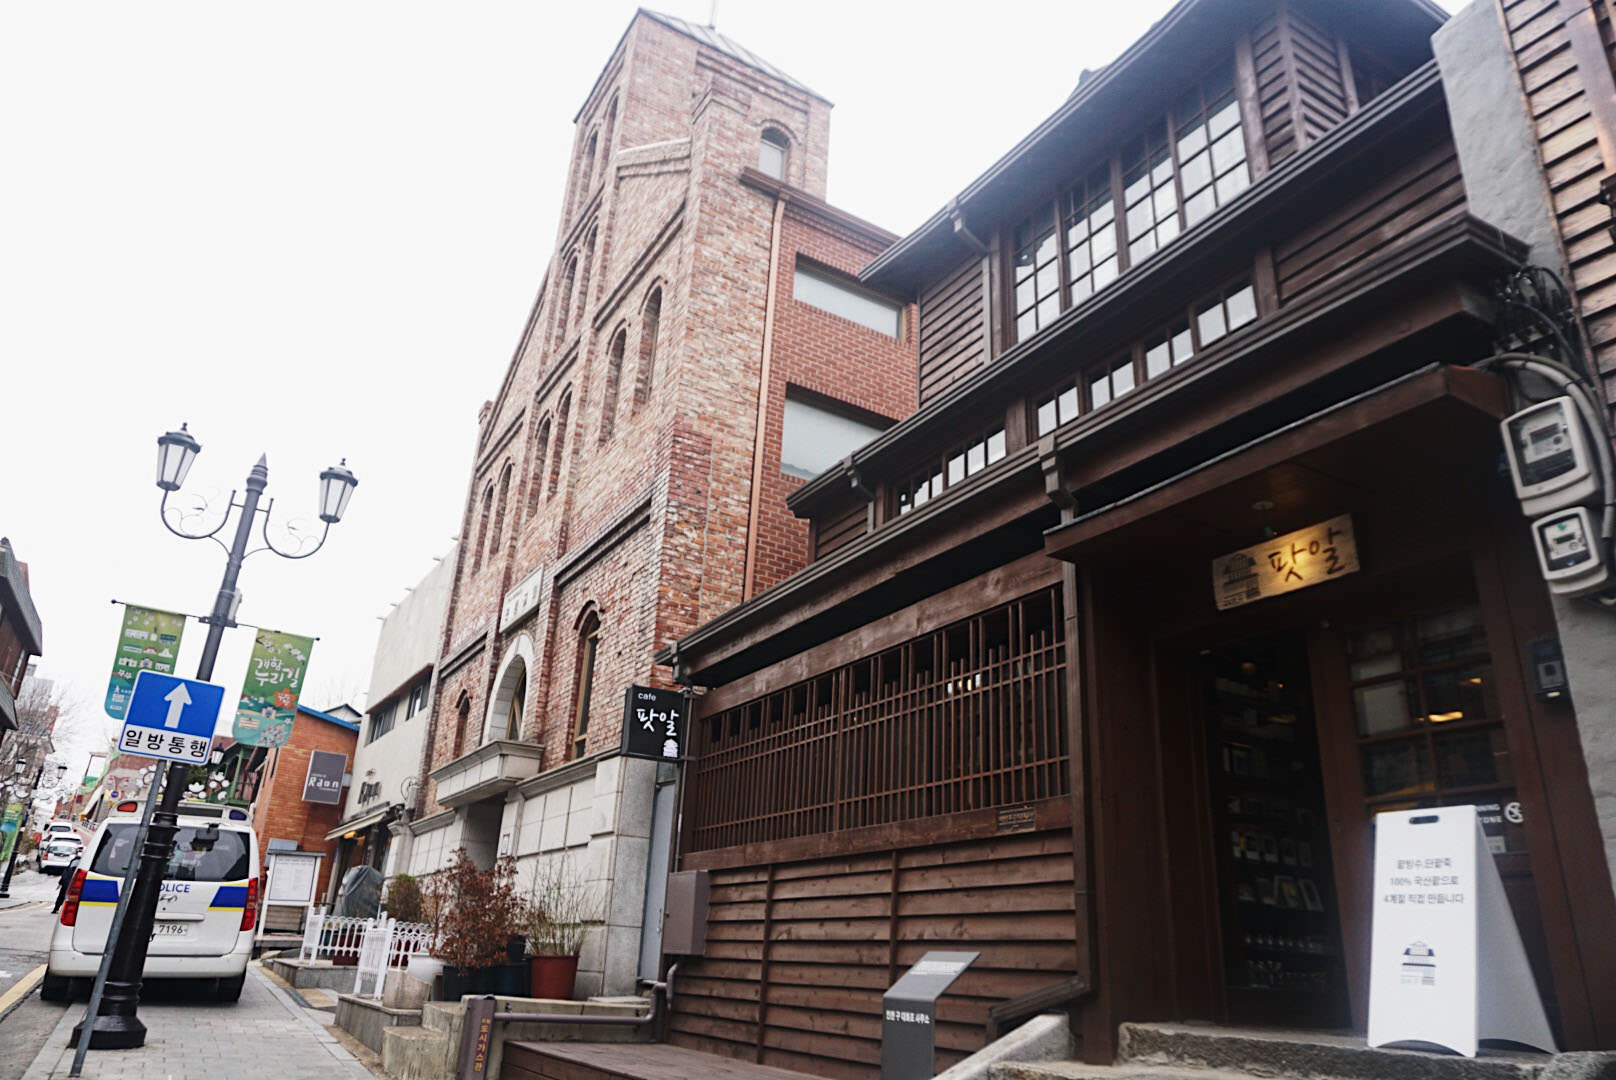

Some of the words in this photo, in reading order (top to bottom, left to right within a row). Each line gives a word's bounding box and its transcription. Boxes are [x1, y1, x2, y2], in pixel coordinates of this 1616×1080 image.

[1268, 527, 1343, 582] 팟알
[254, 656, 284, 671] 개항
[255, 667, 300, 688] 누리길
[638, 692, 656, 702] cafe
[636, 708, 680, 736] 팟알
[125, 729, 207, 758] 일방통행
[160, 883, 190, 893] OLICE
[1390, 877, 1412, 886] 100%
[159, 924, 183, 934] 7196
